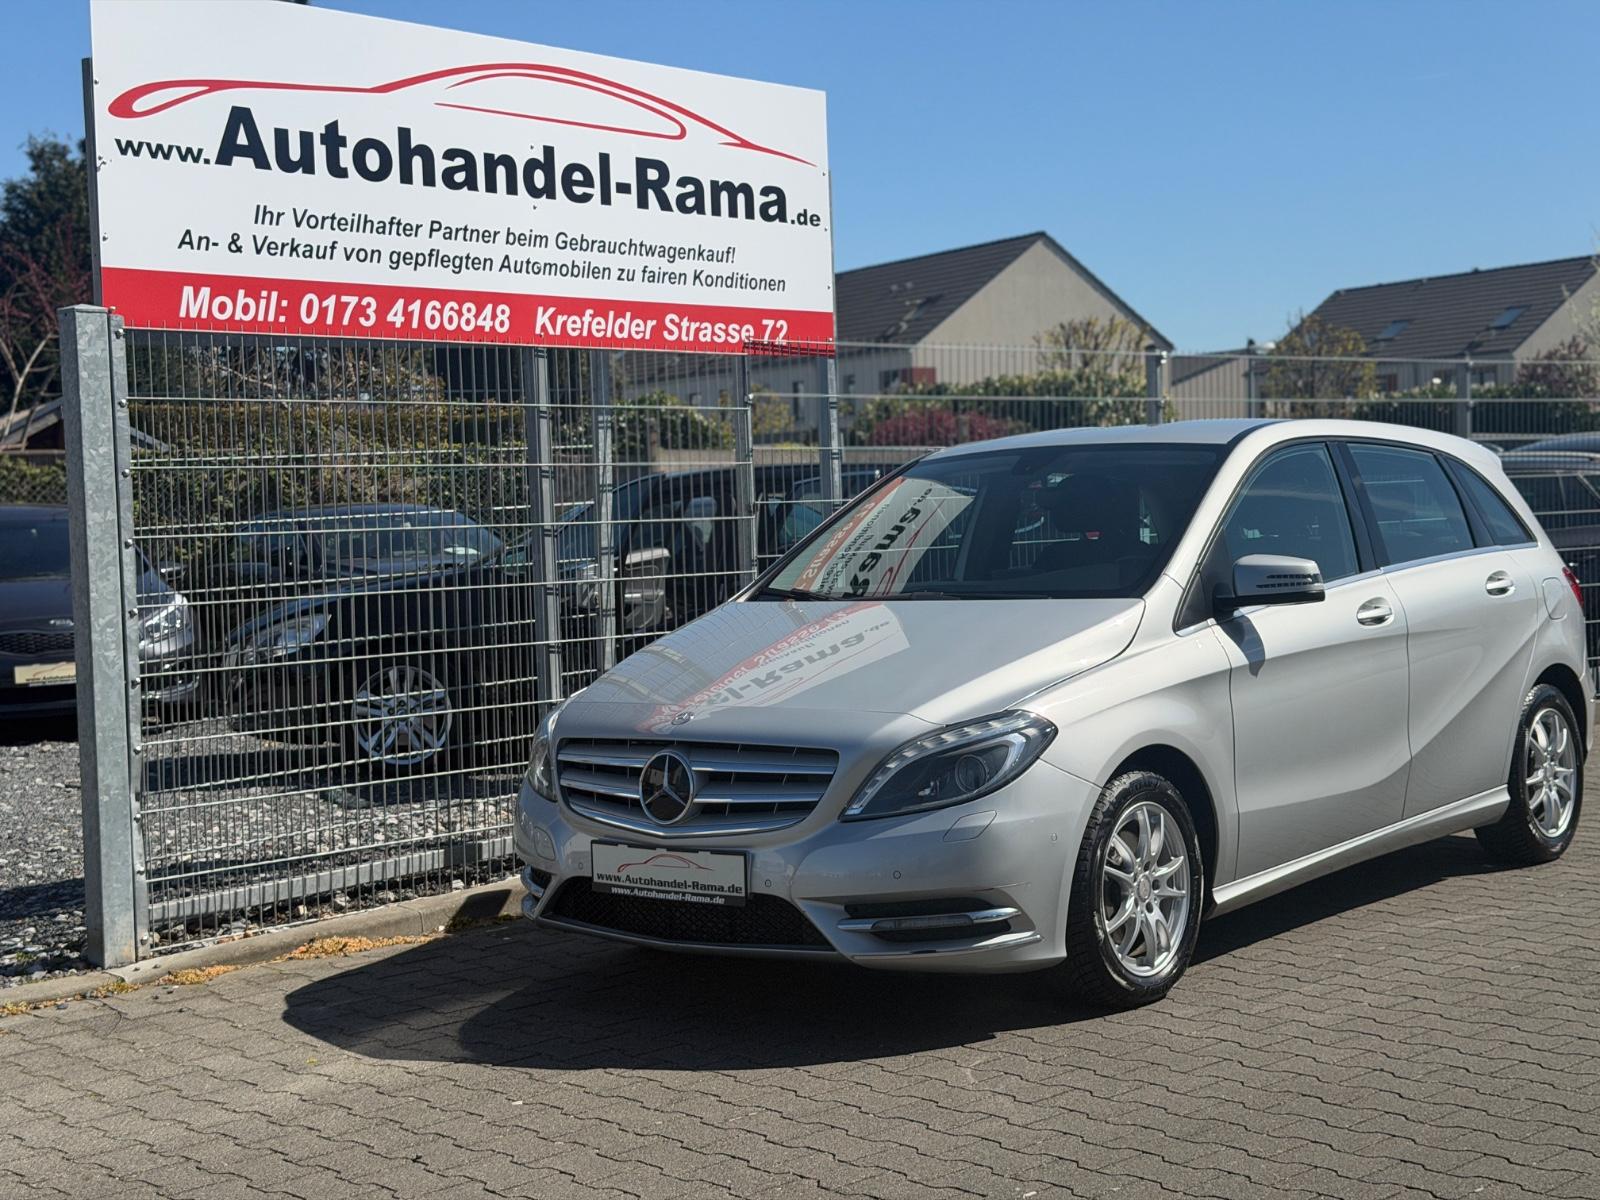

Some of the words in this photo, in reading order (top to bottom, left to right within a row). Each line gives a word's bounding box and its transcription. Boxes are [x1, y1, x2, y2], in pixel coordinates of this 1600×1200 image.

[114, 105, 821, 227] www.Autohandel-Rama.de
[177, 228, 219, 252] An-
[227, 232, 243, 254] &
[252, 235, 338, 260] Verkauf
[343, 247, 382, 264] von
[389, 249, 494, 275] gepflegten
[499, 254, 612, 280] Automobilen
[617, 267, 636, 282] zu
[641, 265, 687, 286] fairen
[693, 269, 786, 292] Konditionen
[254, 204, 285, 226] Ihr
[292, 208, 423, 238] Vorteilhafter
[428, 220, 501, 244] Partner
[505, 227, 549, 249] beim
[555, 232, 736, 263] Gebrauchtwagenkauf!
[179, 285, 288, 323] Mobil:
[300, 293, 377, 327] 0173
[386, 298, 511, 334] 4166848
[535, 306, 657, 341] Krefelder
[663, 313, 755, 344] Strasse
[761, 319, 788, 346] 72
[597, 873, 742, 894] www.Autohandel-Rama.de
[611, 886, 725, 905] www.Autohandel-Rama.de
